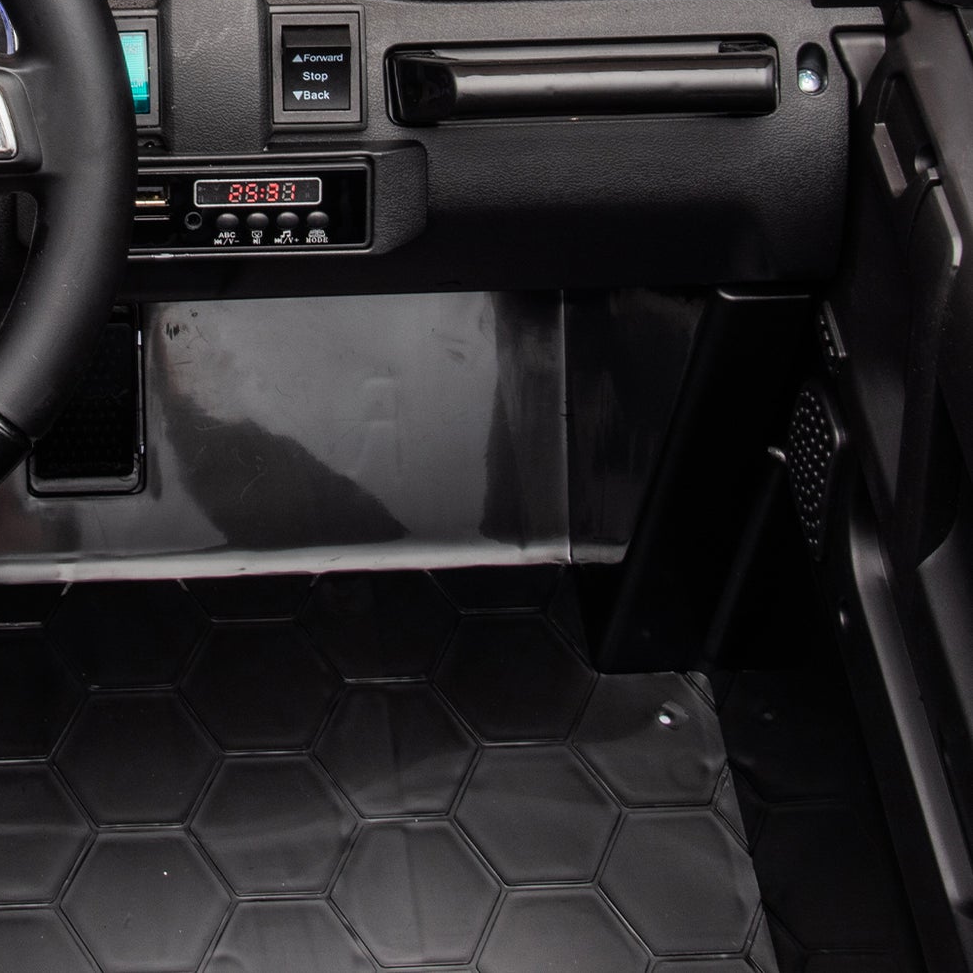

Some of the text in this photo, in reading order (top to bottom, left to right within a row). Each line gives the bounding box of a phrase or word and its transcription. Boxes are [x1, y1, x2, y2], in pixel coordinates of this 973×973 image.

[303, 53, 344, 62] Forward
[302, 71, 329, 82] Stop
[303, 90, 330, 100] Back
[218, 231, 236, 239] ABC
[306, 236, 329, 244] MODE
